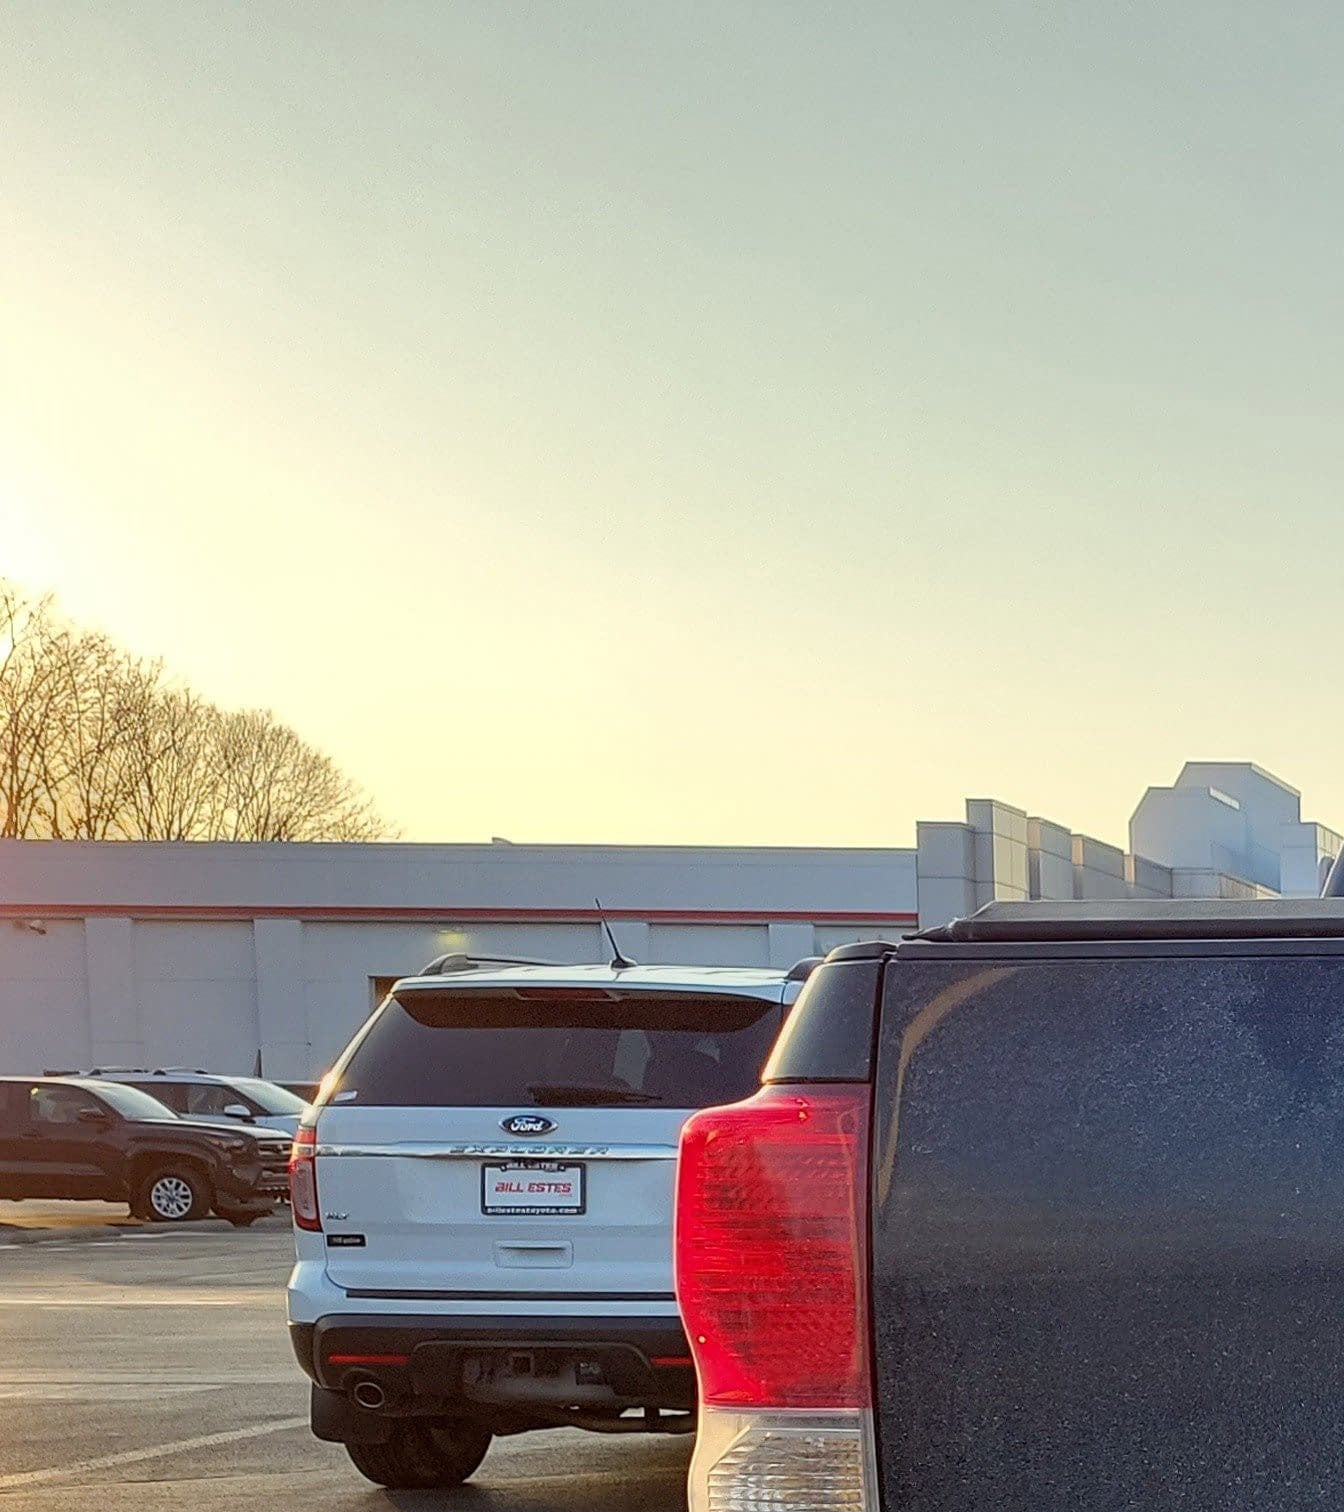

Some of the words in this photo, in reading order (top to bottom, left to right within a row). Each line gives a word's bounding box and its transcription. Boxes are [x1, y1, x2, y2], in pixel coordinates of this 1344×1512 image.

[510, 1118, 543, 1131] Ford
[495, 1182, 524, 1193] BILL
[527, 1182, 572, 1193] ESTES
